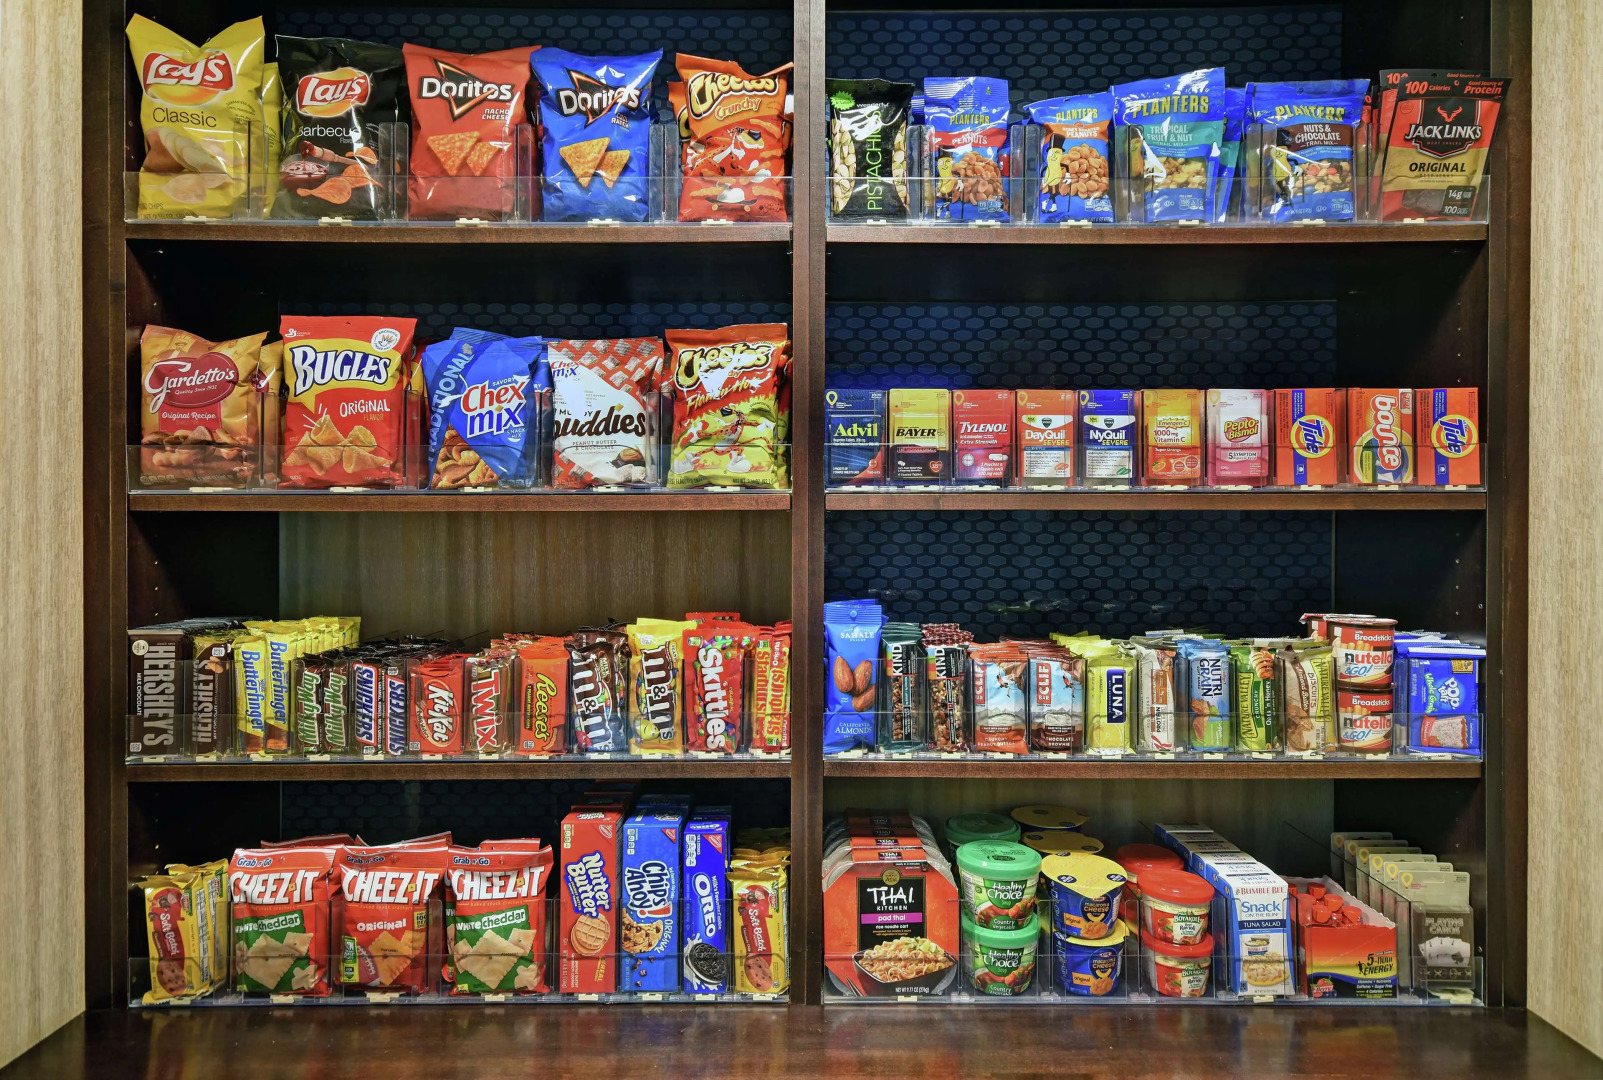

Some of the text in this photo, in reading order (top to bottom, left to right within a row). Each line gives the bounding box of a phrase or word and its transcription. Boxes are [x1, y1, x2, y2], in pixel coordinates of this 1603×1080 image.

[146, 51, 226, 87] Lay's
[302, 76, 362, 106] Lay's
[421, 77, 513, 101] Doritos
[1405, 81, 1429, 94] 100
[1464, 85, 1502, 94] Protein
[559, 87, 641, 115] Doritos
[715, 97, 762, 120] Crunchy
[1132, 95, 1210, 119] PLANTERS
[152, 107, 217, 128] Classic
[950, 114, 990, 126] PLANTERS
[1056, 108, 1099, 122] PLANTERS
[1274, 104, 1346, 122] PLANTERS
[952, 132, 988, 145] PEANUTS
[1066, 130, 1099, 139] PEANUTS
[1147, 133, 1193, 142] FRUIT & NUT
[1294, 132, 1341, 144] CHOCOLATE
[1303, 124, 1332, 133] NUTS &
[1405, 124, 1482, 140] JACK LINK'S
[1409, 162, 1466, 172] ORIGINAL
[290, 345, 391, 398] BUGLES
[551, 360, 580, 369] Chex
[144, 361, 236, 414] Gardetto's
[492, 377, 516, 387] SAVORY
[462, 381, 529, 413] Chex
[161, 411, 216, 421] Original Recipe
[467, 402, 525, 438] mix
[1223, 419, 1259, 433] Pepto-
[833, 423, 879, 437] Advil
[896, 428, 937, 437] BAYER
[959, 422, 1008, 433] TYLENOL
[1025, 430, 1066, 441] DayQuil
[1089, 430, 1125, 442] NyQuil
[1228, 426, 1258, 440] Bismol
[1298, 418, 1325, 454] Tide
[1374, 396, 1400, 468] bounce
[1438, 418, 1467, 454] Tide
[1228, 452, 1233, 460] 5
[1354, 633, 1392, 642] Breadsticks
[892, 644, 903, 676] KIND
[934, 647, 947, 679] KIND
[1344, 651, 1393, 665] nutella
[269, 641, 288, 725] Butterfinger
[756, 650, 771, 718] Starburst
[1038, 665, 1050, 695] CLIF
[1199, 658, 1213, 697] GRAIN
[1208, 658, 1223, 697] NUTRI
[1313, 660, 1331, 691] NATURE
[142, 645, 176, 746] HERSHEY'S
[241, 650, 265, 732] Butterfinger
[698, 648, 730, 750] Skittles
[1111, 674, 1123, 719] LUNA
[1264, 680, 1272, 702] Honey
[1307, 672, 1317, 708] BISCUITS
[324, 672, 347, 746] Milky Way
[355, 665, 374, 742] SNICKERS
[534, 673, 557, 742] Reese's
[766, 669, 785, 736] Starburst
[1239, 674, 1255, 736] NATURE VALLEY
[1253, 690, 1261, 719] CRUNCHY
[1319, 691, 1332, 721] VALLEY
[1351, 698, 1390, 706] Breadsticks
[298, 703, 322, 745] Milky
[388, 680, 405, 756] SNICKERS
[1343, 715, 1392, 730] nutella
[834, 726, 873, 735] ALMONDS
[453, 857, 470, 865] Grab
[478, 857, 490, 866] Go
[567, 861, 599, 919] Butter
[582, 852, 610, 910] Nutter
[641, 861, 671, 909] Chips
[992, 881, 1026, 893] Healthy
[1241, 886, 1286, 895] BUMBLE BEE
[695, 873, 717, 938] OREO
[867, 887, 914, 906] THAI
[987, 889, 1023, 900] Choice
[1241, 901, 1281, 913] Snack
[749, 908, 767, 952] Soft Batch
[1065, 916, 1081, 925] original
[1425, 917, 1464, 927] PLAYING
[1429, 925, 1461, 935] CARDS
[159, 913, 179, 956] Soft Batch
[654, 919, 674, 954] ORIGINAL
[984, 955, 1019, 968] Choice
[989, 949, 1022, 960] Healthy
[1363, 962, 1394, 976] ENERGY
